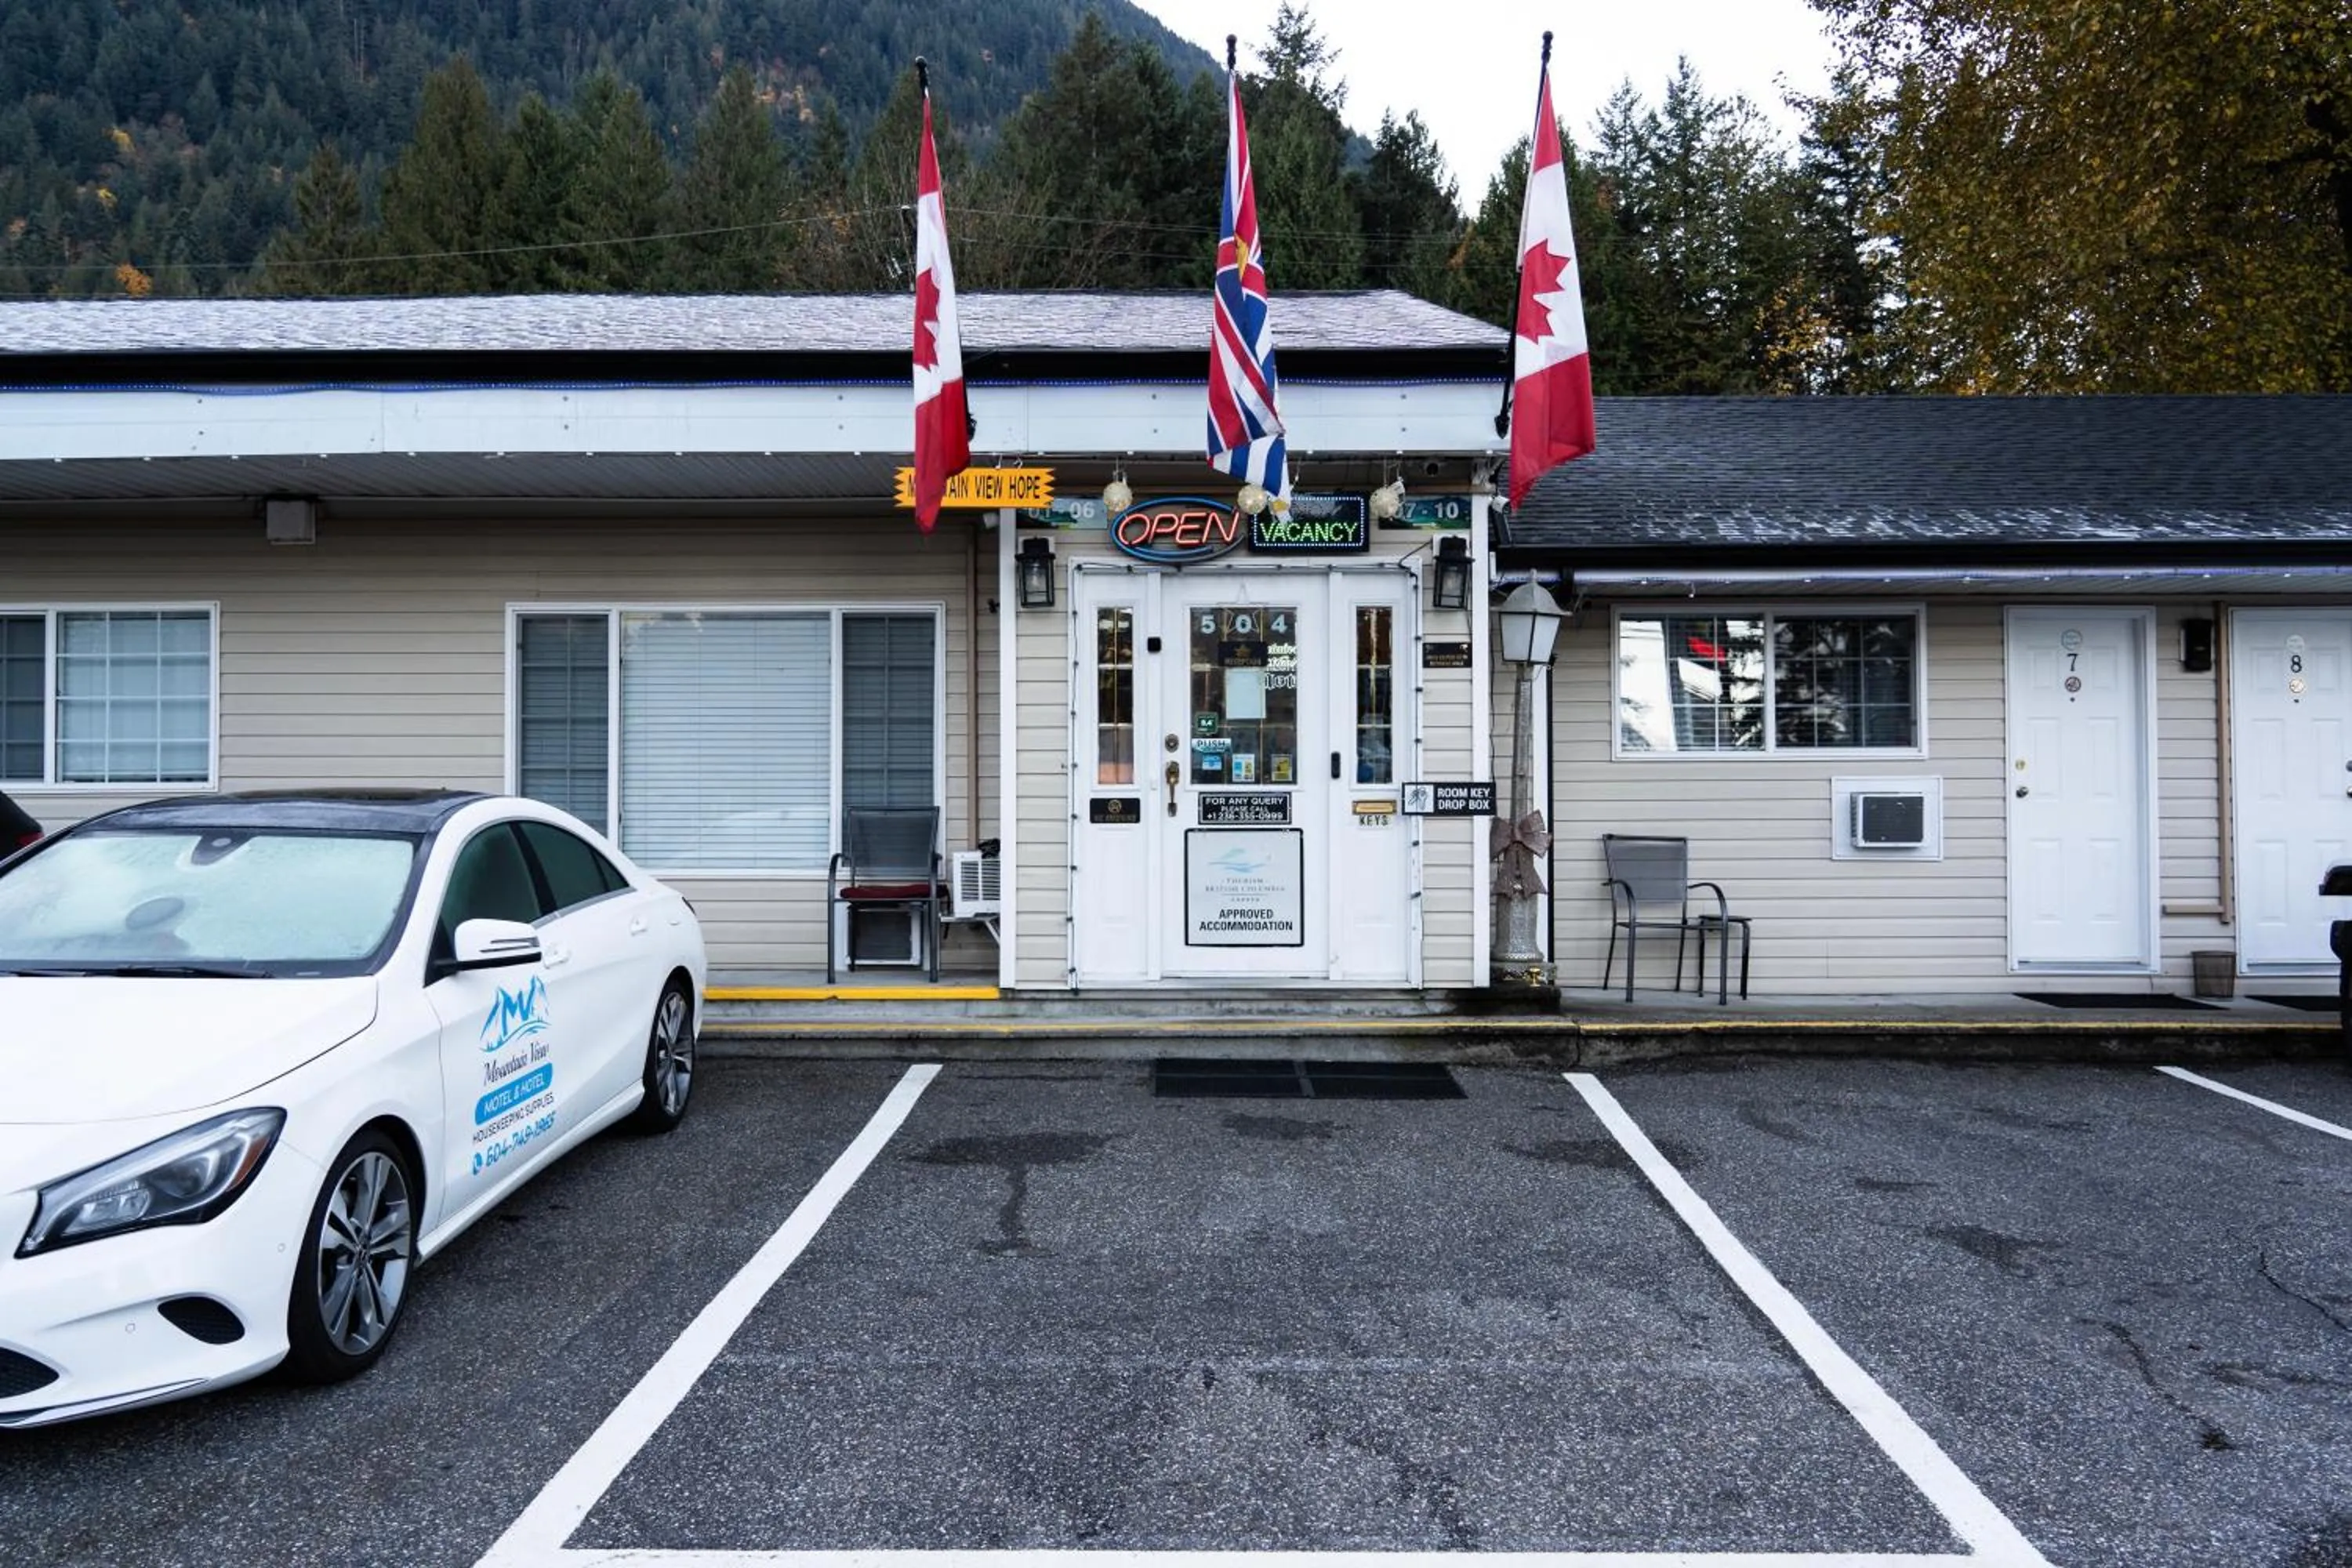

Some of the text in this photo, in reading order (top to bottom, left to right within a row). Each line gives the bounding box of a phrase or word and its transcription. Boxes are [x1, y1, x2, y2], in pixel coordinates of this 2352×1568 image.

[907, 474, 1040, 499] MAIN VIEW HOPE
[1069, 502, 1094, 518] 06
[1434, 502, 1458, 518] 10
[1118, 511, 1240, 544] OPEN
[1259, 522, 1358, 542] VACANCY
[2067, 653, 2078, 672] 7
[2290, 655, 2303, 673] 8
[1437, 787, 1490, 797] ROOM KEY
[1438, 800, 1490, 810] DROP BOX
[1359, 815, 1389, 826] KEYS
[1218, 909, 1274, 920] APPROVED
[1199, 921, 1293, 931] ACCOMMODATION
[484, 1041, 550, 1087] Mountain View
[484, 1092, 512, 1116] MOTEL
[521, 1073, 544, 1097] HOTEL
[472, 1091, 555, 1144] HOUSEKEEPING SUPPLIES
